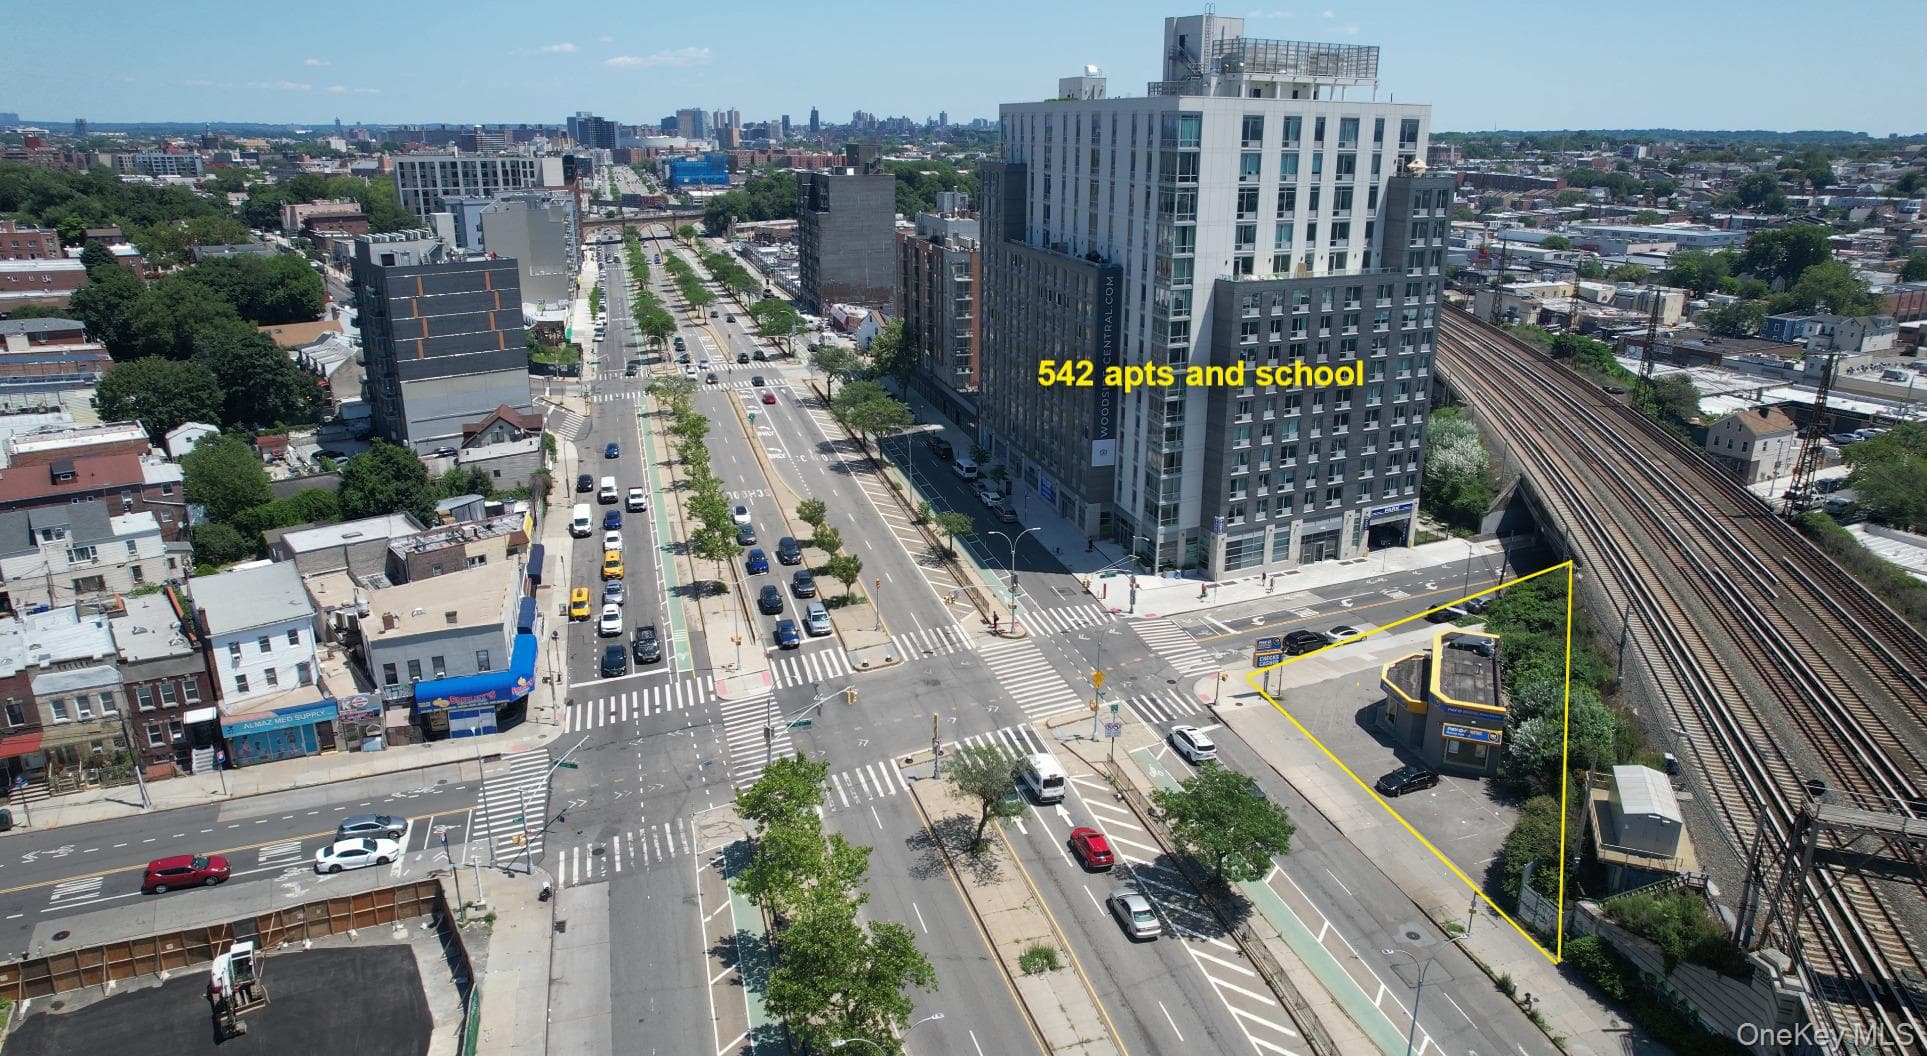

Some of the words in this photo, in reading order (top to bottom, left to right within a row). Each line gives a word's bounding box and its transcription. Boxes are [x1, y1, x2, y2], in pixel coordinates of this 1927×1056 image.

[243, 719, 272, 730] ALMAZ
[274, 715, 293, 726] MED
[294, 709, 326, 721] SUPPLY
